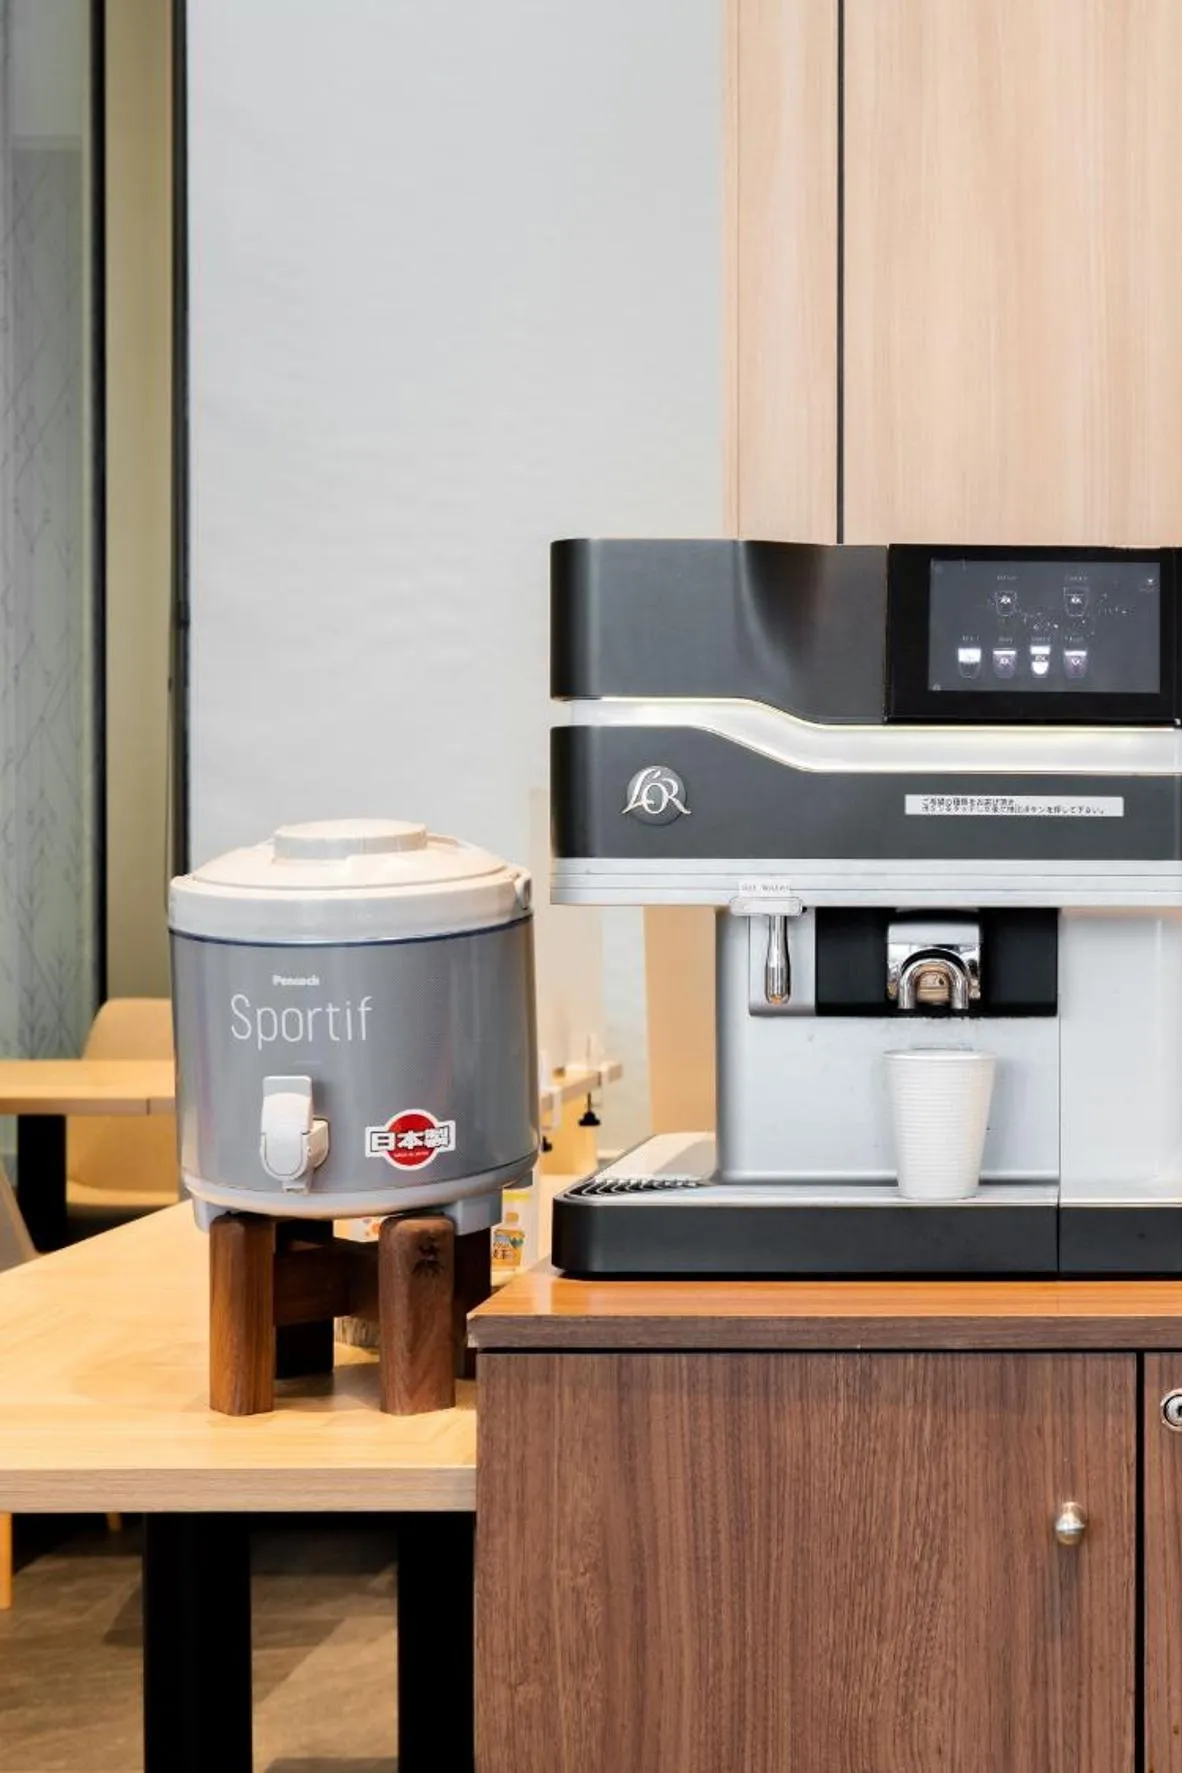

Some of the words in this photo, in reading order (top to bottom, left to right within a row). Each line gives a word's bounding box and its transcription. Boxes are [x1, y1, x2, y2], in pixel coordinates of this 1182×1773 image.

[230, 993, 373, 1050] Sportif
[369, 1128, 451, 1152] 日本製
